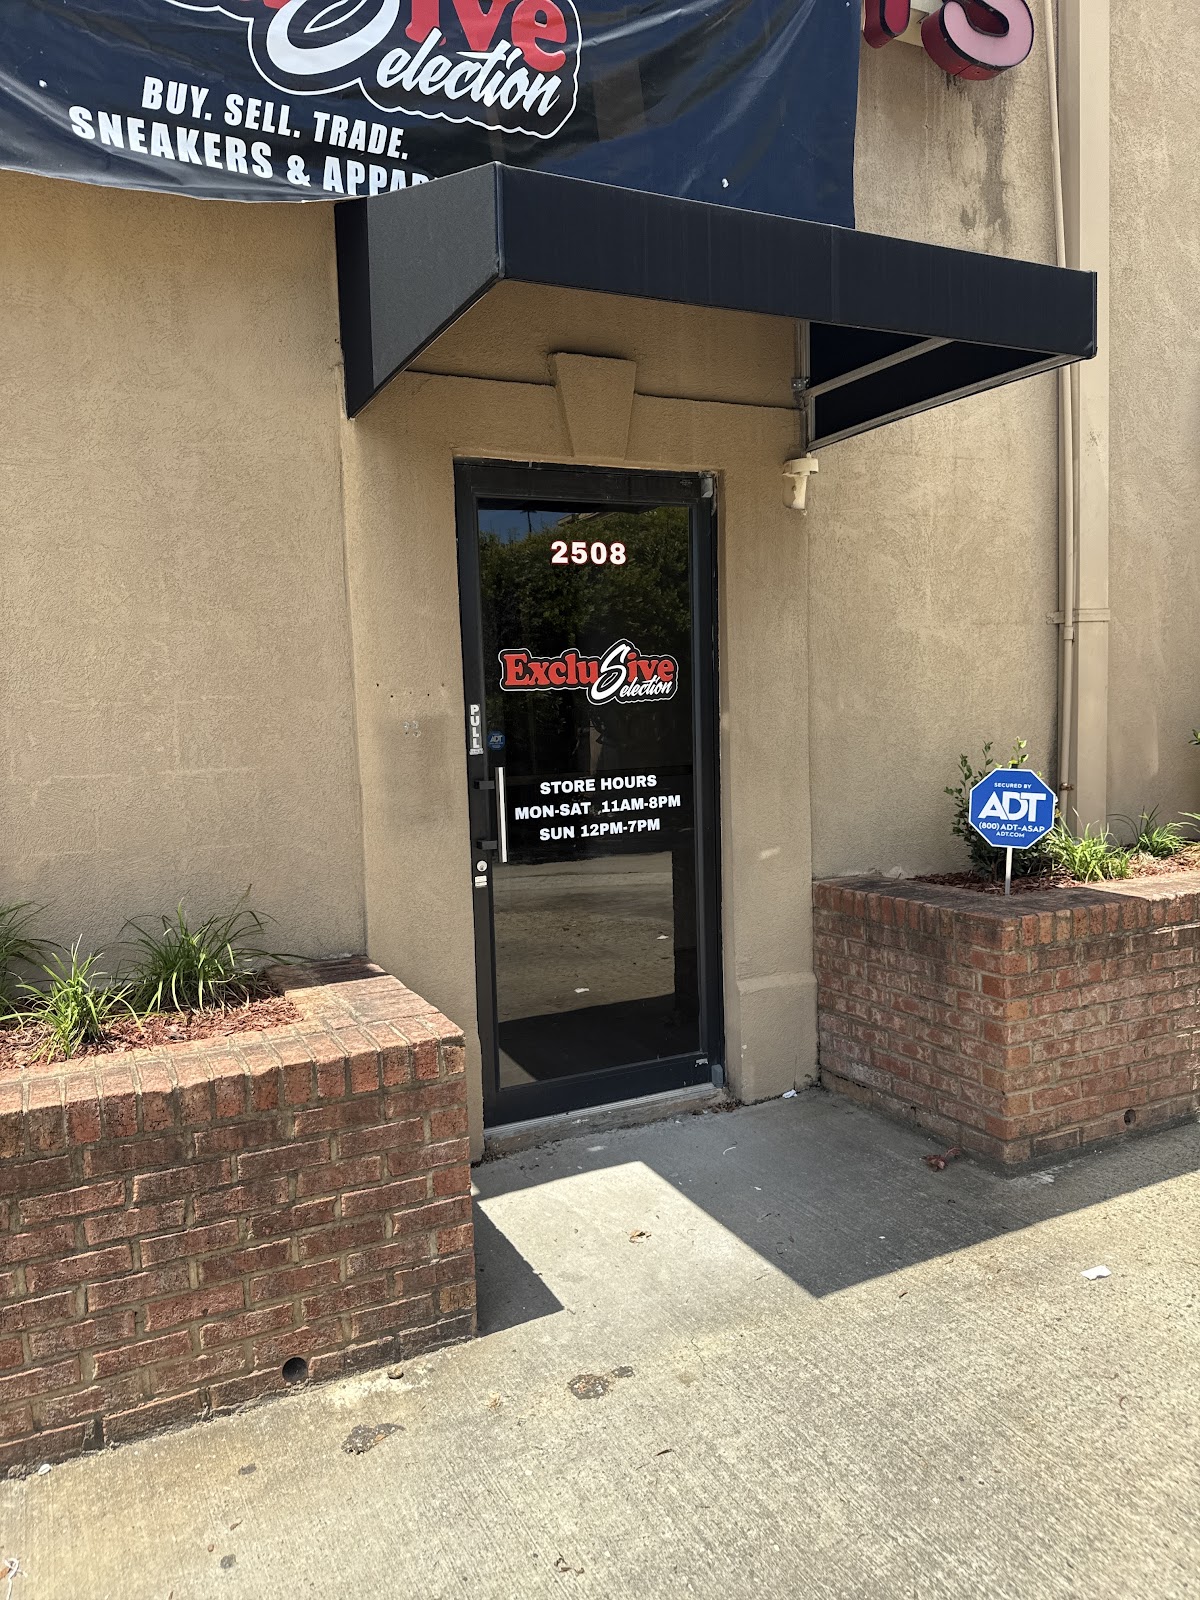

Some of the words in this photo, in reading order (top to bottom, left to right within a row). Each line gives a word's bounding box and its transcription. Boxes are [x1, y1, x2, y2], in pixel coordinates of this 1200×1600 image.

[141, 76, 213, 121] BUY.
[223, 93, 300, 138] SELL.
[313, 111, 409, 160] TRADE.
[68, 105, 274, 178] SNEAKERS
[286, 154, 312, 187] &
[322, 155, 439, 196] APPA
[550, 540, 627, 565] 2508
[470, 704, 480, 749] PULL
[540, 779, 596, 795] STORE
[600, 774, 657, 791] HOURS
[514, 802, 592, 820] MON-SAT
[601, 795, 681, 813] 11AM-8PM
[977, 791, 1047, 822] ADT
[539, 826, 575, 841] SUN
[580, 818, 661, 838] 12PM-7PM
[979, 821, 1000, 831] (800)
[1000, 823, 1045, 833] ADT-ASAP
